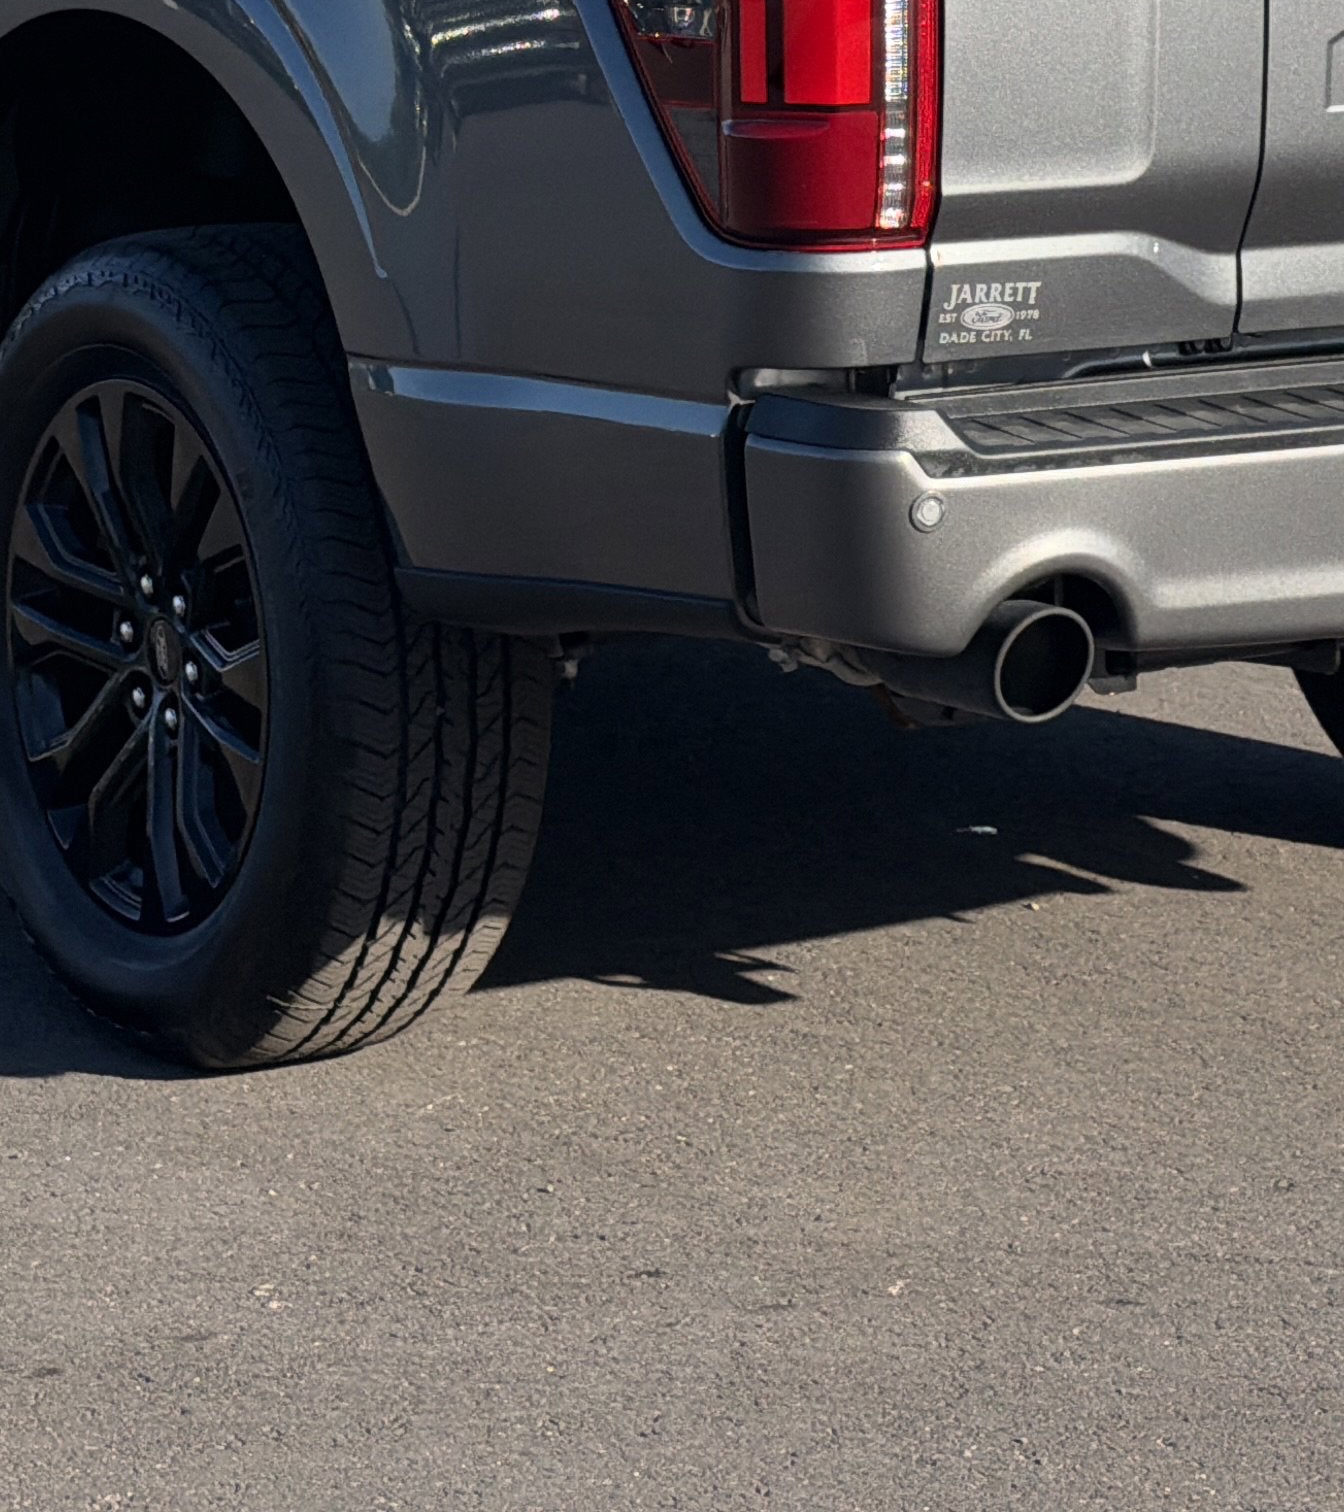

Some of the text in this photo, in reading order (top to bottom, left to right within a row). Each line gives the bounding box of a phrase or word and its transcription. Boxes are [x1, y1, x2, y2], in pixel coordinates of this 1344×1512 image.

[943, 281, 1042, 310] JARRETT
[938, 313, 958, 323] EST
[939, 328, 1033, 344] DADE CITY, FL
